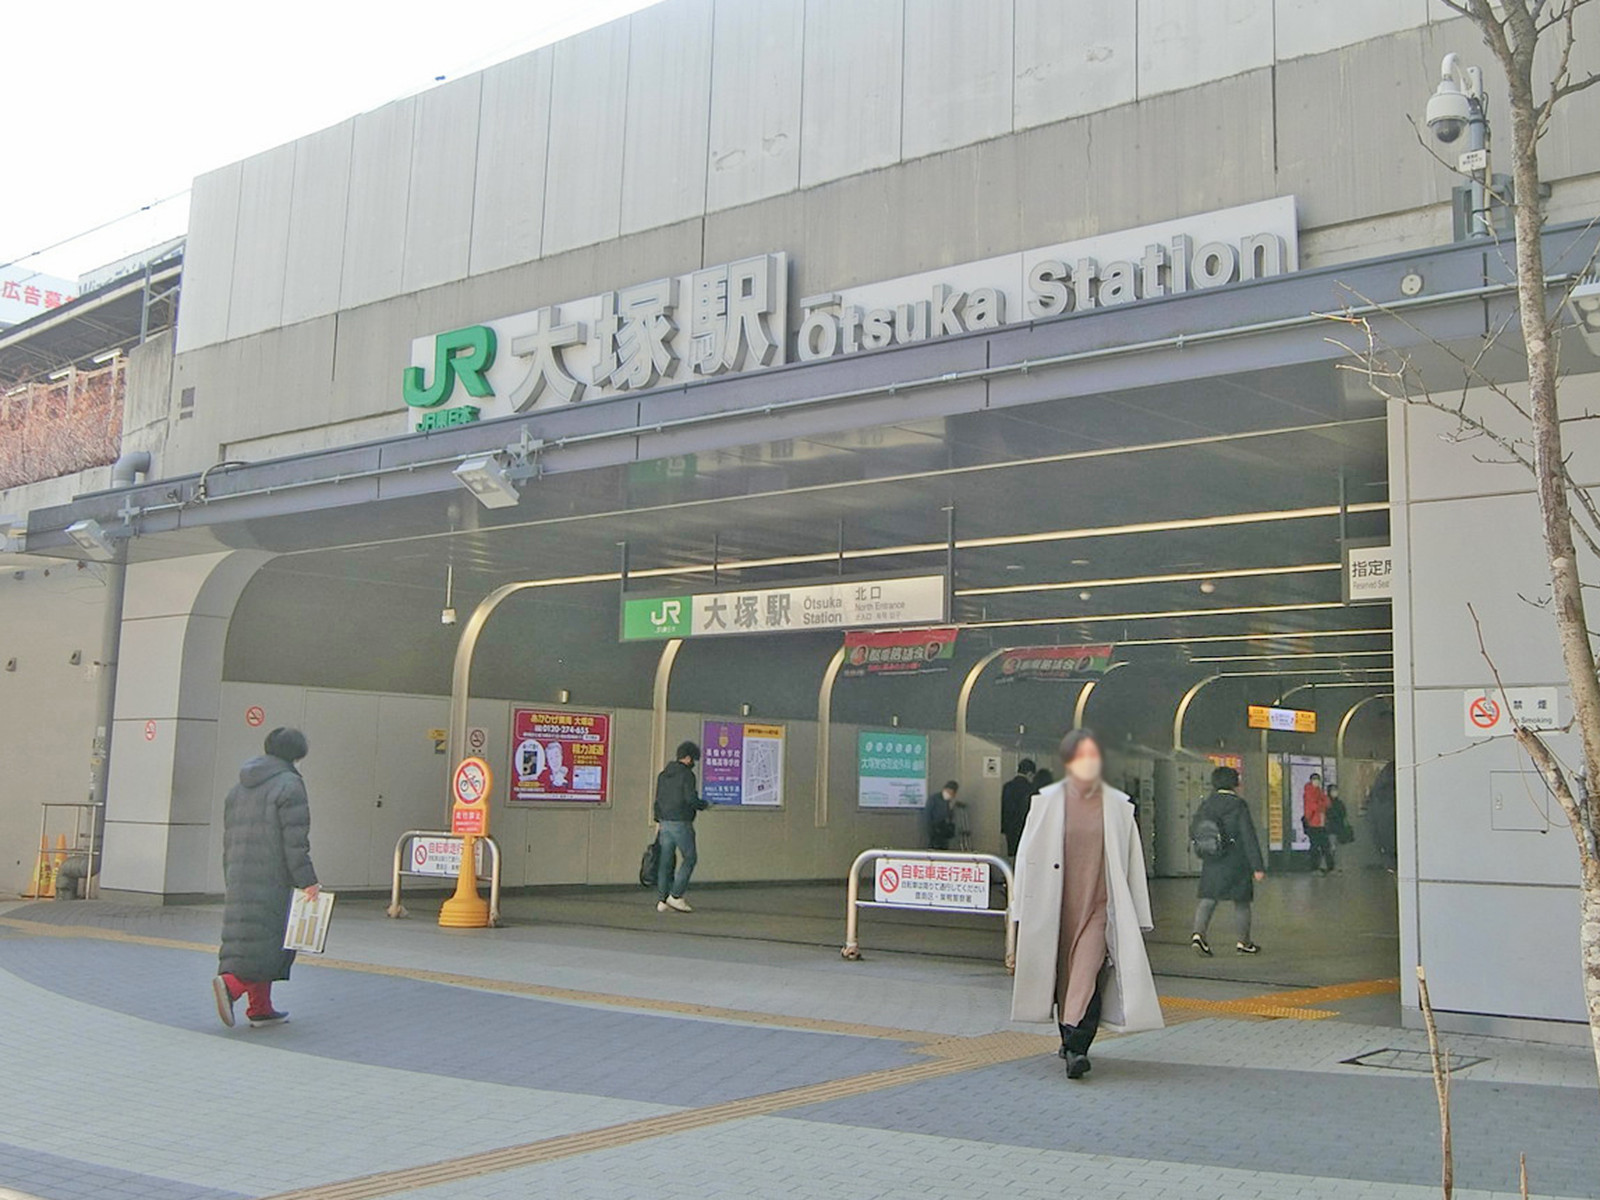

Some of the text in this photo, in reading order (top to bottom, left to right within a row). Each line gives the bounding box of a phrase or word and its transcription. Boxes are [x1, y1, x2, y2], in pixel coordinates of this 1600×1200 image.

[1027, 231, 1286, 317] Station
[508, 253, 780, 413] 大塚駅
[403, 325, 496, 408] JR
[855, 586, 881, 600] 北口
[651, 600, 681, 625] JR
[703, 593, 791, 630] 大塚駅
[855, 601, 905, 612] North Entrance
[803, 611, 842, 625] Station
[1521, 716, 1552, 725] Smoking
[901, 864, 985, 883] 自転車走行禁止
